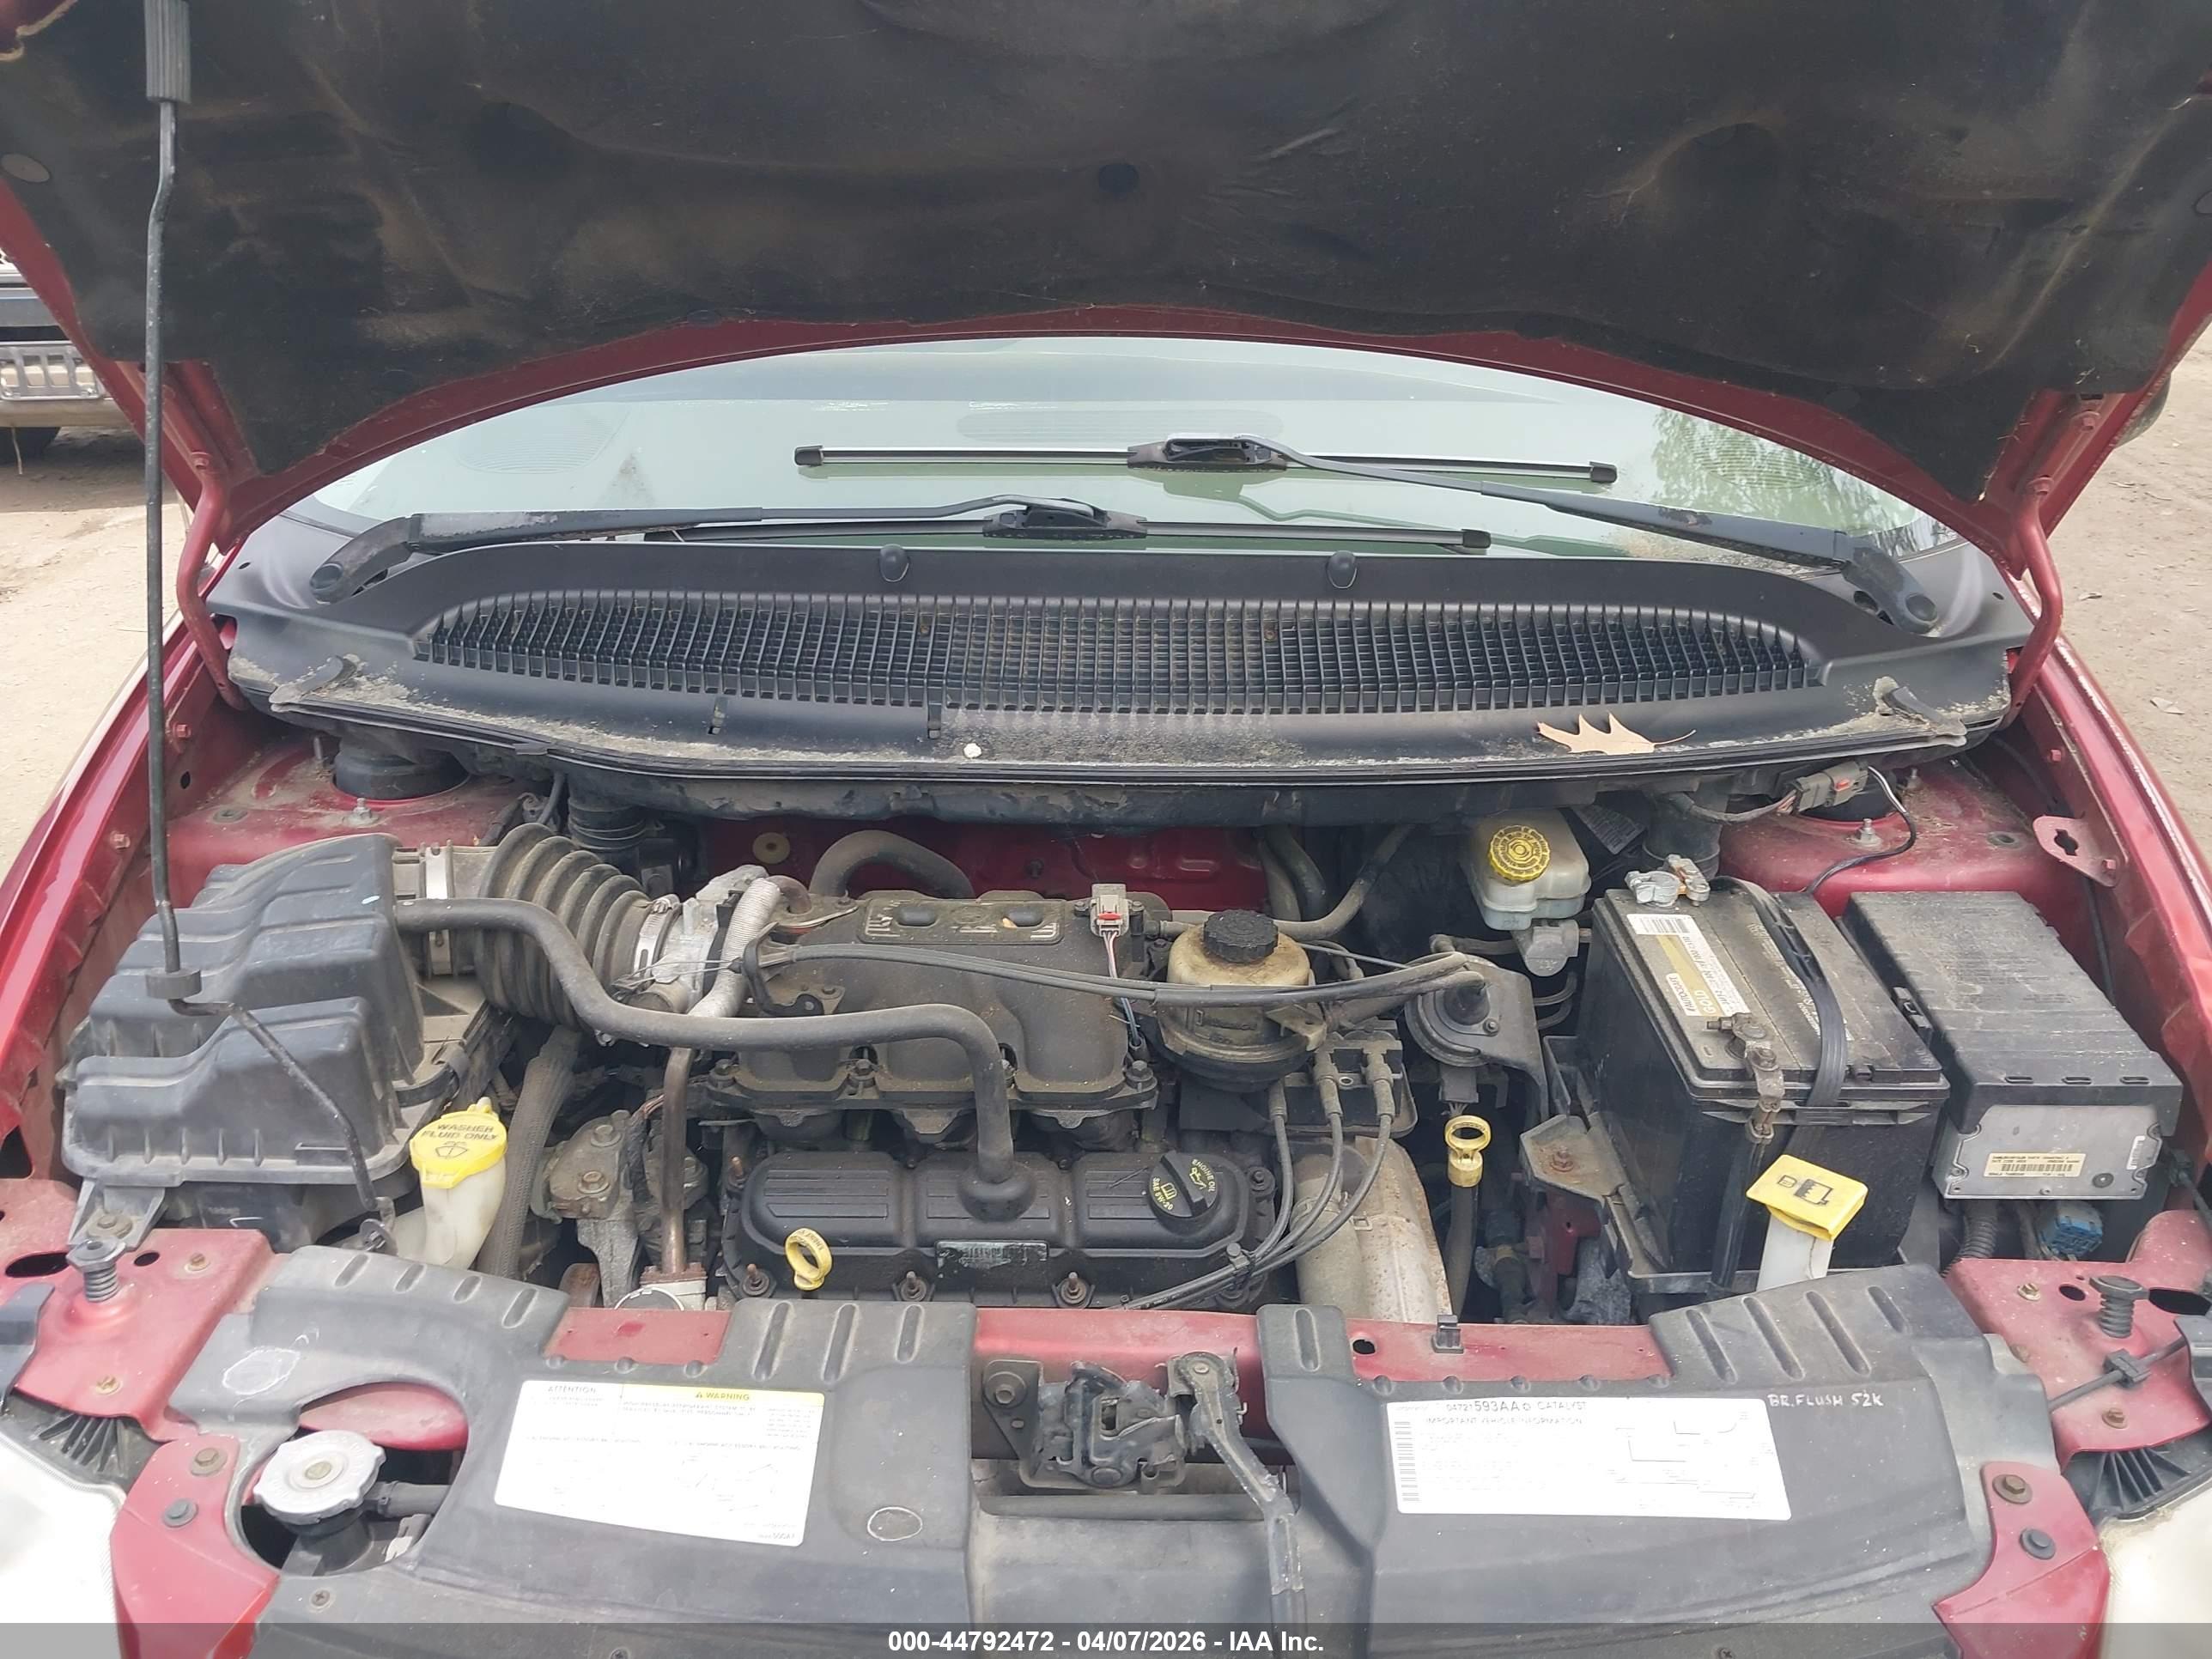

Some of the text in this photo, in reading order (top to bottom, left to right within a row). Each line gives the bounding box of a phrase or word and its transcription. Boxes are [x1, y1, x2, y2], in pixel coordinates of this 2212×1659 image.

[1694, 989, 1717, 1014] GOLD
[436, 1123, 495, 1133] WASHER
[420, 1130, 460, 1139] FLUID
[1192, 1158, 1216, 1193] ENGINE OIL
[1152, 1176, 1162, 1192] SAE
[547, 1385, 597, 1394] ATTENTION
[706, 1391, 750, 1401] WARNING
[1850, 1392, 1885, 1407] 52K
[1537, 1401, 1587, 1411] CATALYST
